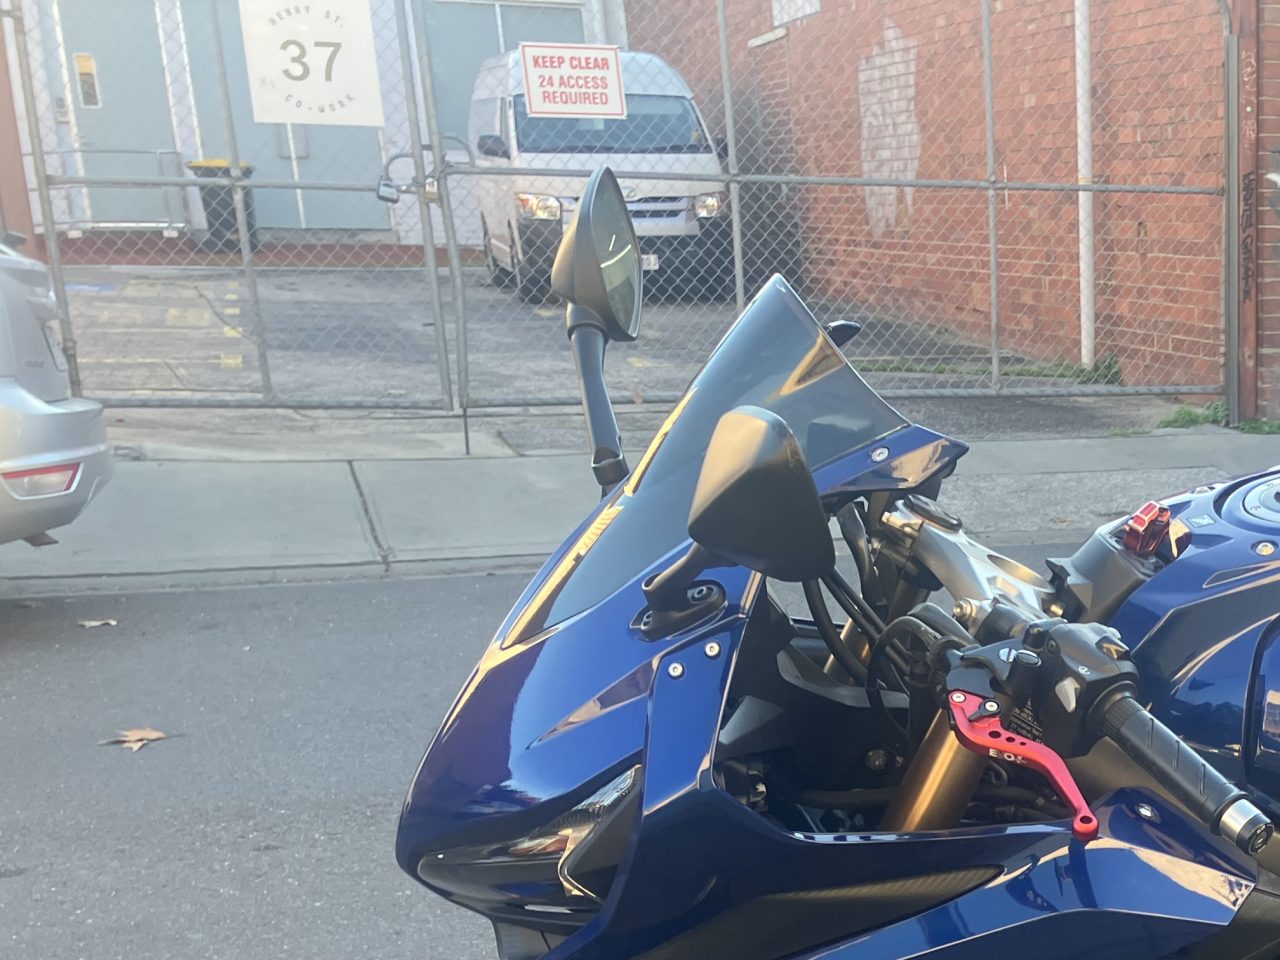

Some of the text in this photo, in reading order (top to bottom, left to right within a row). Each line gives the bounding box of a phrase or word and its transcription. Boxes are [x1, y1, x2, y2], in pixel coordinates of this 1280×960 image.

[279, 39, 342, 82] 37
[532, 55, 610, 70] KEEP CLEAR
[538, 74, 609, 89] 24 ACCESS
[284, 94, 356, 113] CO-WORK
[542, 91, 609, 105] REQUIRED
